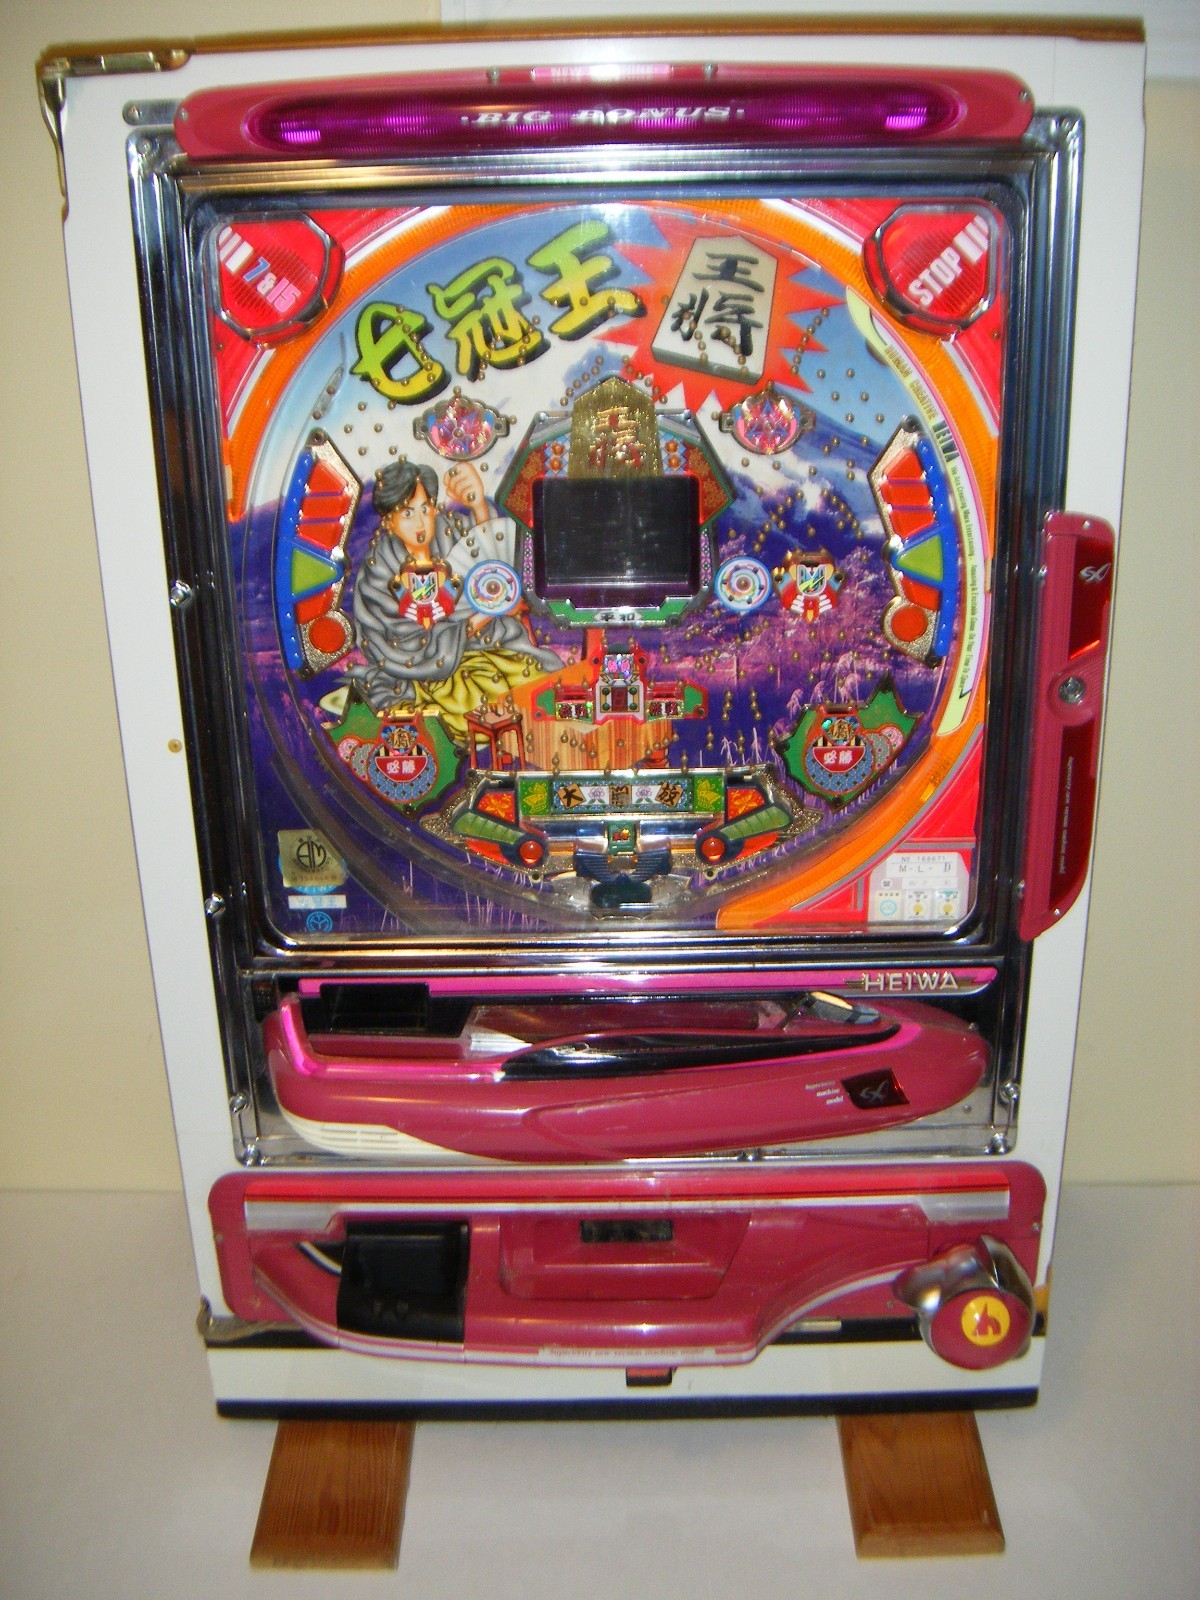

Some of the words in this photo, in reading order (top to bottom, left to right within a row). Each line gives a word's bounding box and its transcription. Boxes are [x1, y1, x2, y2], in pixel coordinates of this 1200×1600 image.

[471, 110, 552, 122] BIG
[571, 107, 730, 121] BONUS
[908, 247, 963, 306] STOP
[861, 970, 959, 991] HEIWA
